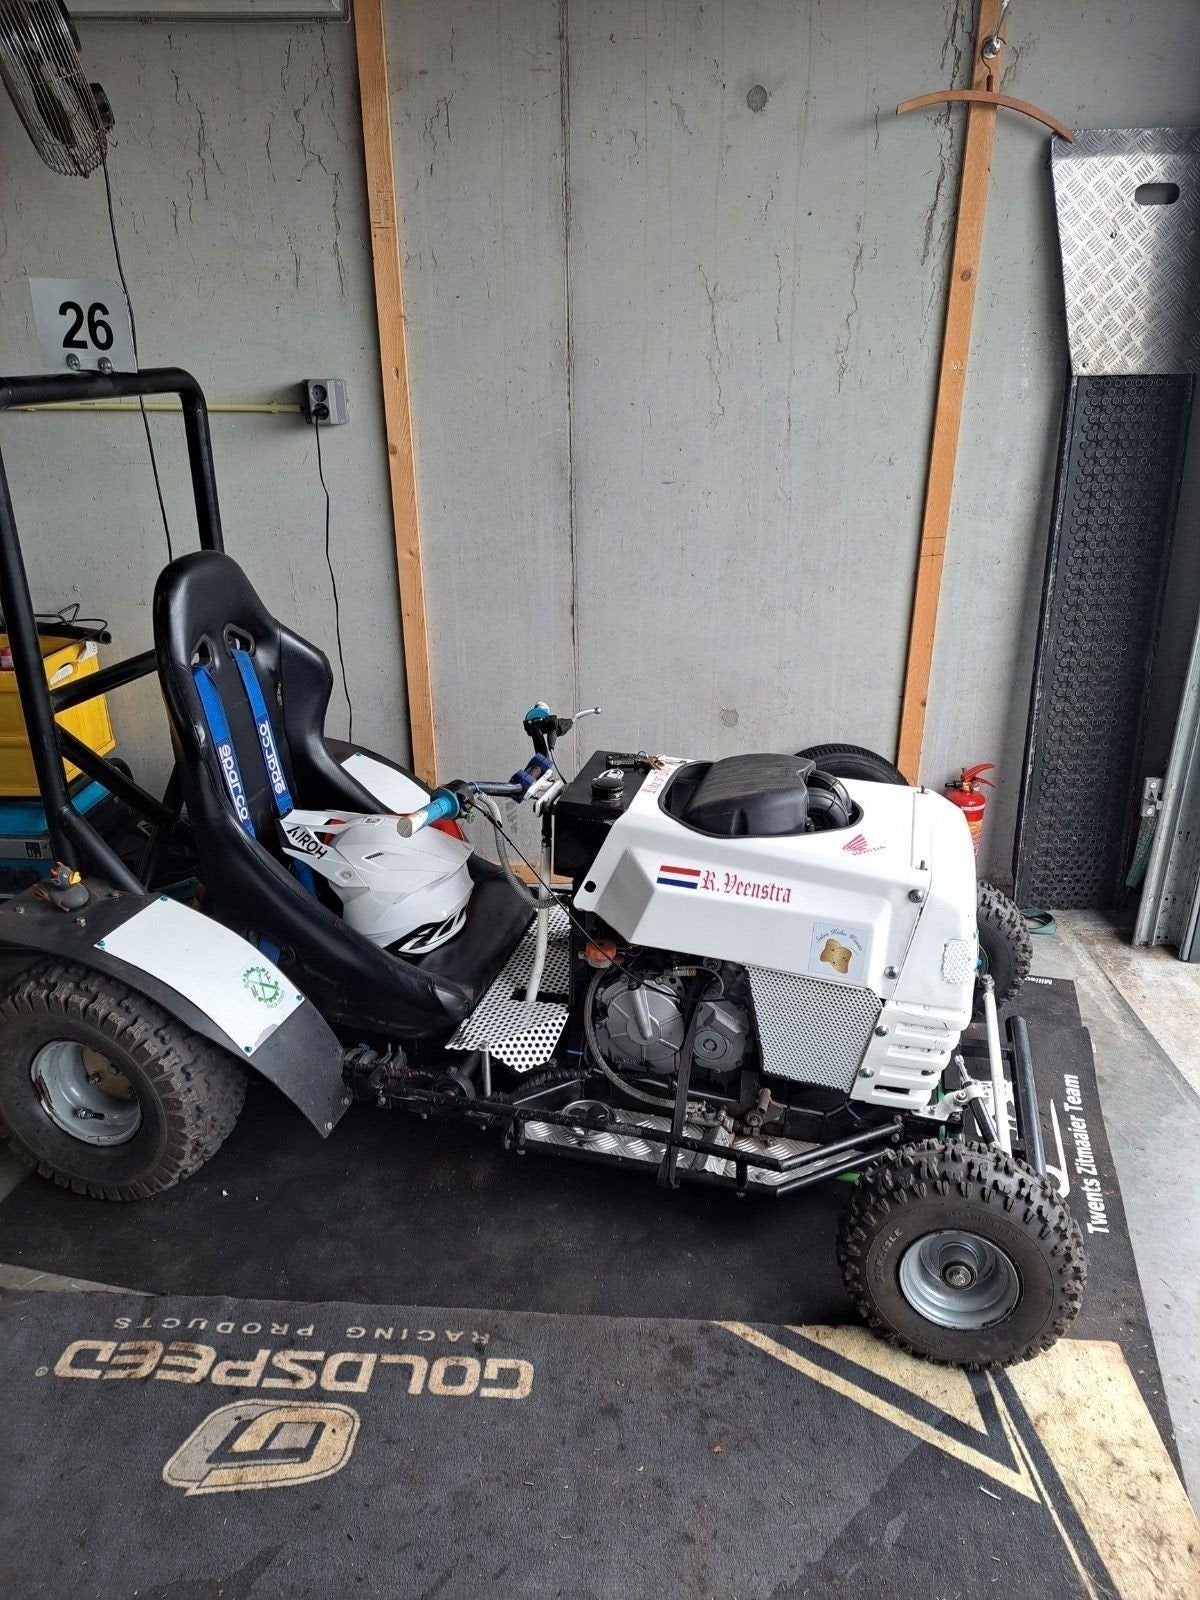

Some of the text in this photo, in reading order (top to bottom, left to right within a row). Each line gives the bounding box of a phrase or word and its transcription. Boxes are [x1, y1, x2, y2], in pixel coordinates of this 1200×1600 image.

[58, 301, 114, 350] 26
[218, 744, 249, 822] sparco
[259, 720, 286, 794] sparco
[286, 826, 328, 859] AIROH
[1063, 1074, 1109, 1234] Twents Zitmaaier Team
[115, 1317, 490, 1343] RACING PRODUCTS
[53, 1339, 535, 1399] GOLDSPEED
